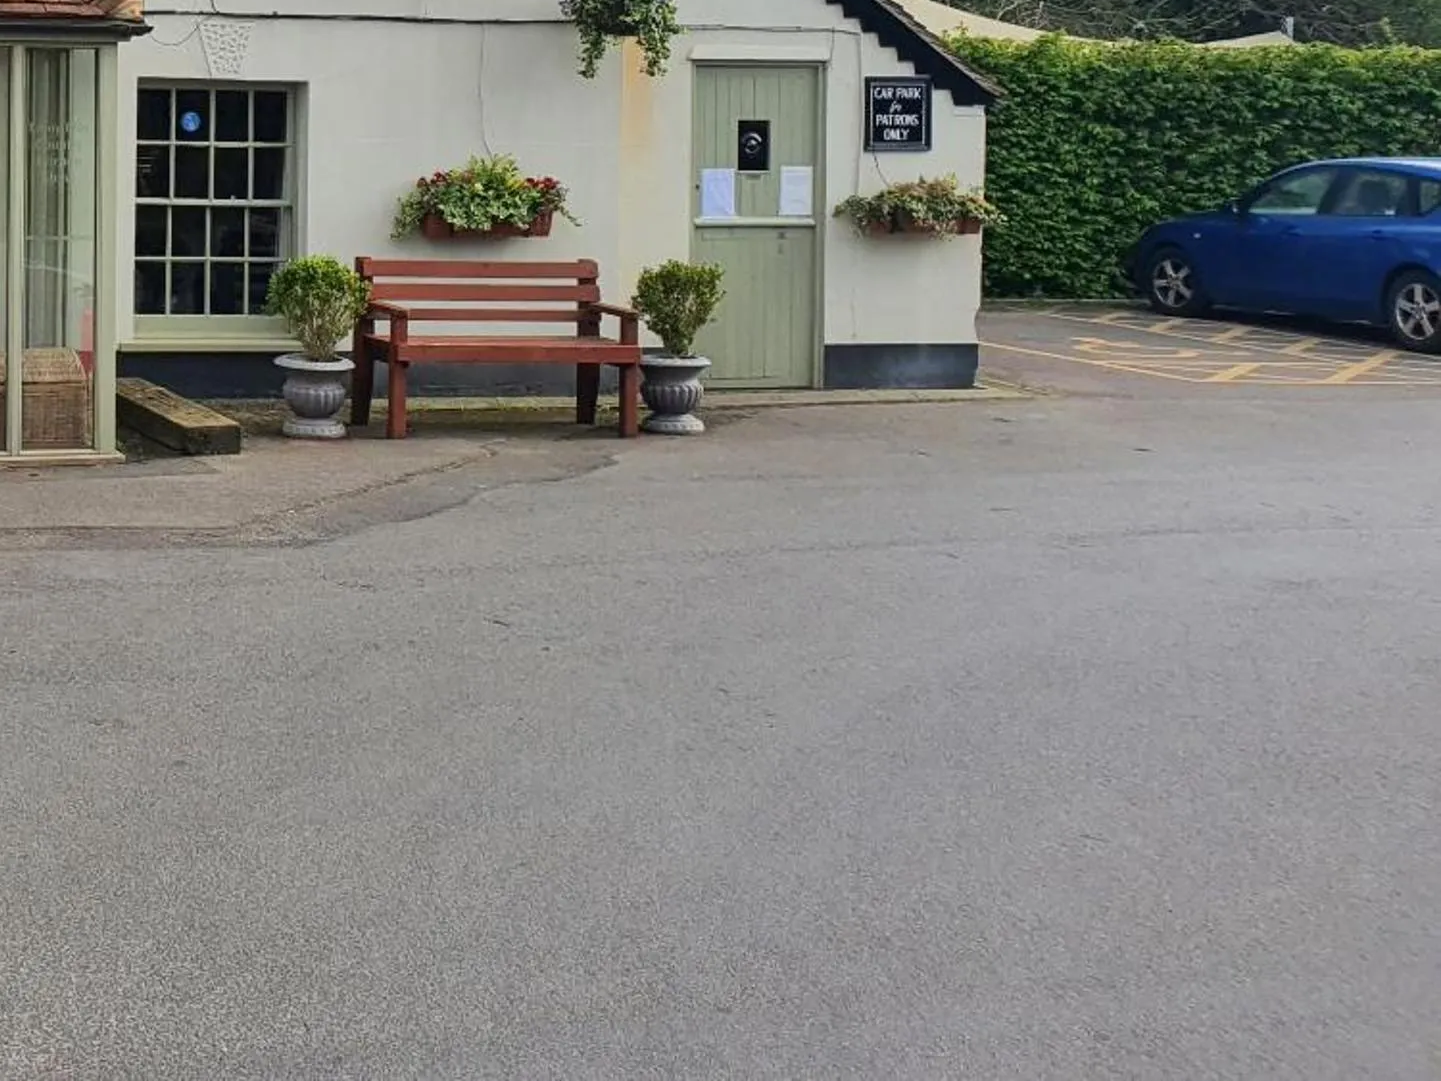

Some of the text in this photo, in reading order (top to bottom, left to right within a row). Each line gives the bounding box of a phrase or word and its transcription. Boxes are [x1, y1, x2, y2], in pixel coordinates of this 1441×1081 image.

[874, 87, 921, 99] CAR PARK
[875, 114, 919, 126] PATRONS
[883, 128, 910, 140] ONLY
